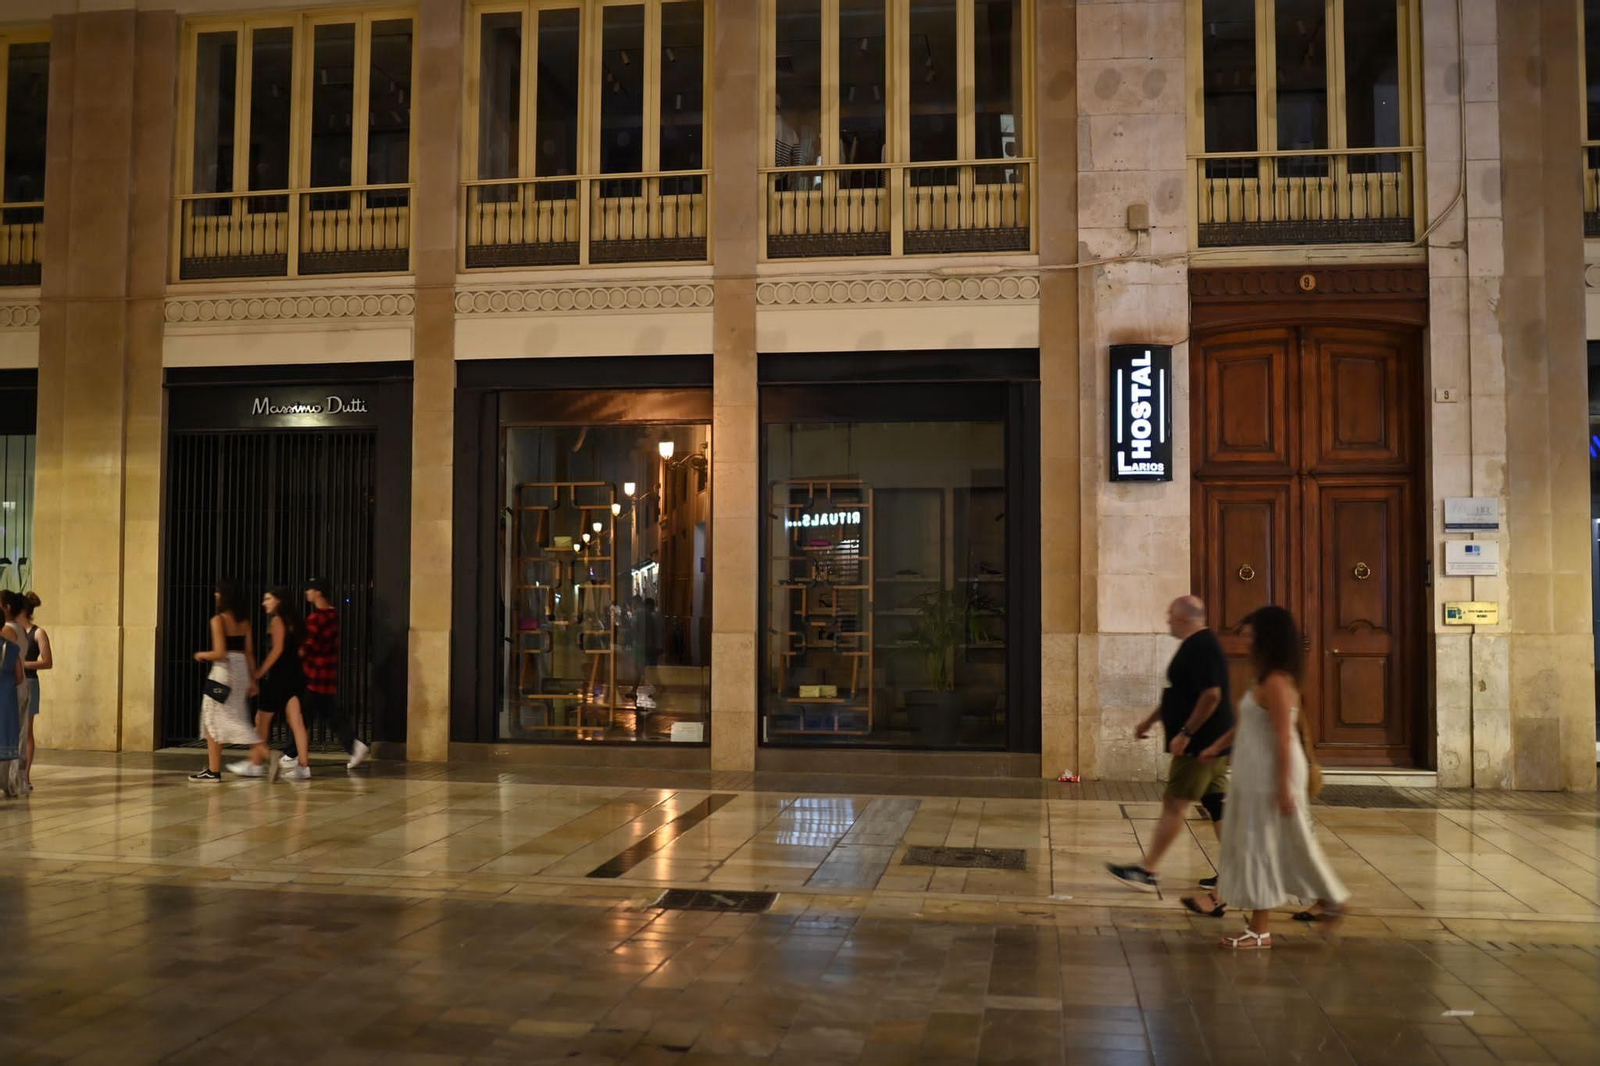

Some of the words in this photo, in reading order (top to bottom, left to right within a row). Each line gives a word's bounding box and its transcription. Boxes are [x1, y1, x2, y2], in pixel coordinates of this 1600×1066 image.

[252, 396, 321, 415] Massimo
[326, 395, 368, 414] Dutti
[1131, 350, 1152, 459] HOSTAL
[1443, 390, 1450, 400] 9
[1117, 451, 1165, 472] LARIOS
